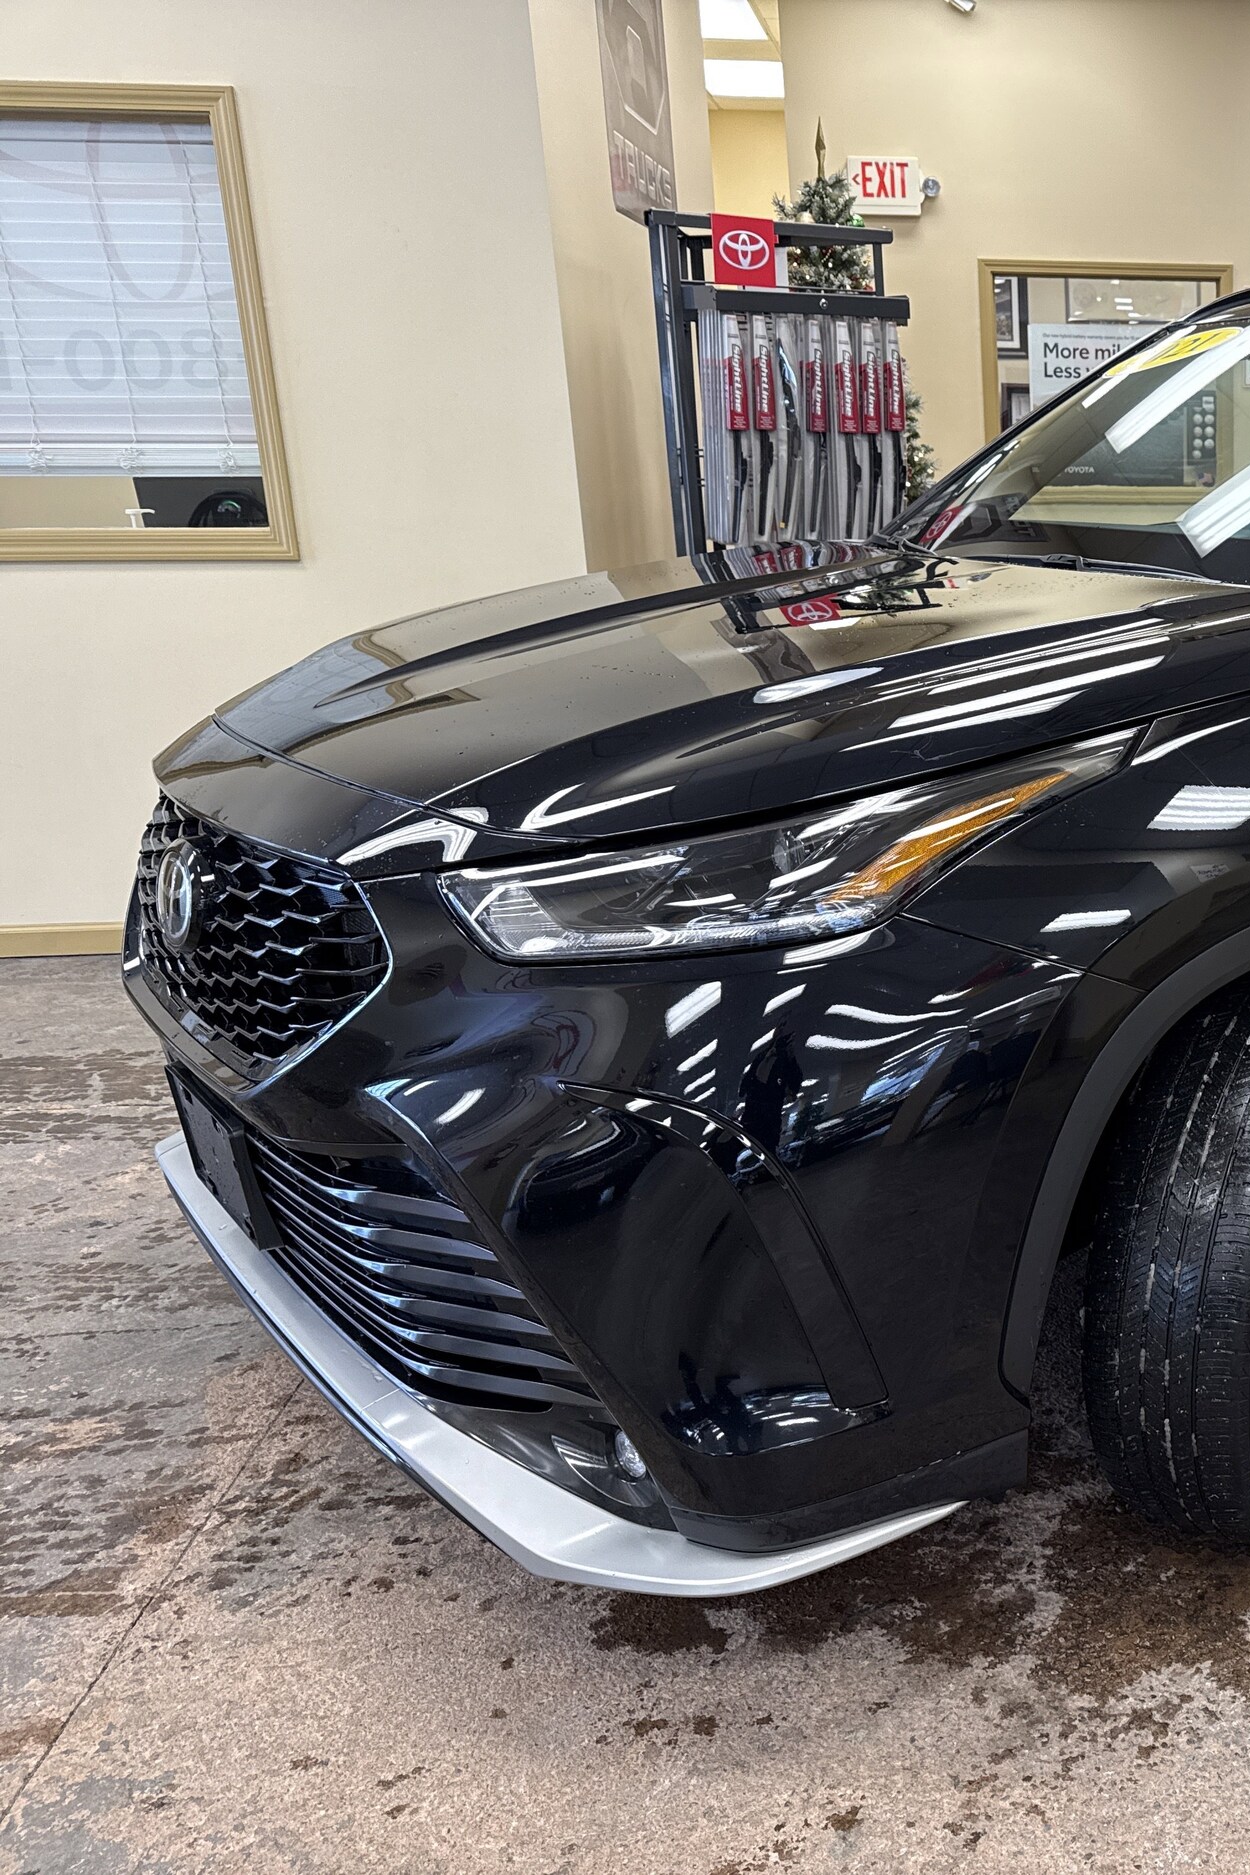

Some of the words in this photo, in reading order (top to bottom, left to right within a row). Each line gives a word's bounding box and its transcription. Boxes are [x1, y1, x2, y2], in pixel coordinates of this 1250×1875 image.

[613, 130, 673, 209] TRUCKS
[861, 162, 908, 198] EXIT
[732, 344, 743, 413] SightLine
[760, 344, 770, 413] SightLine
[814, 349, 823, 415] SightLine
[842, 350, 853, 417] SightLine
[867, 351, 877, 417] SightLine
[892, 349, 901, 415] SightLine
[1043, 342, 1090, 360] More
[1095, 344, 1121, 360] mil
[1044, 362, 1081, 379] Less
